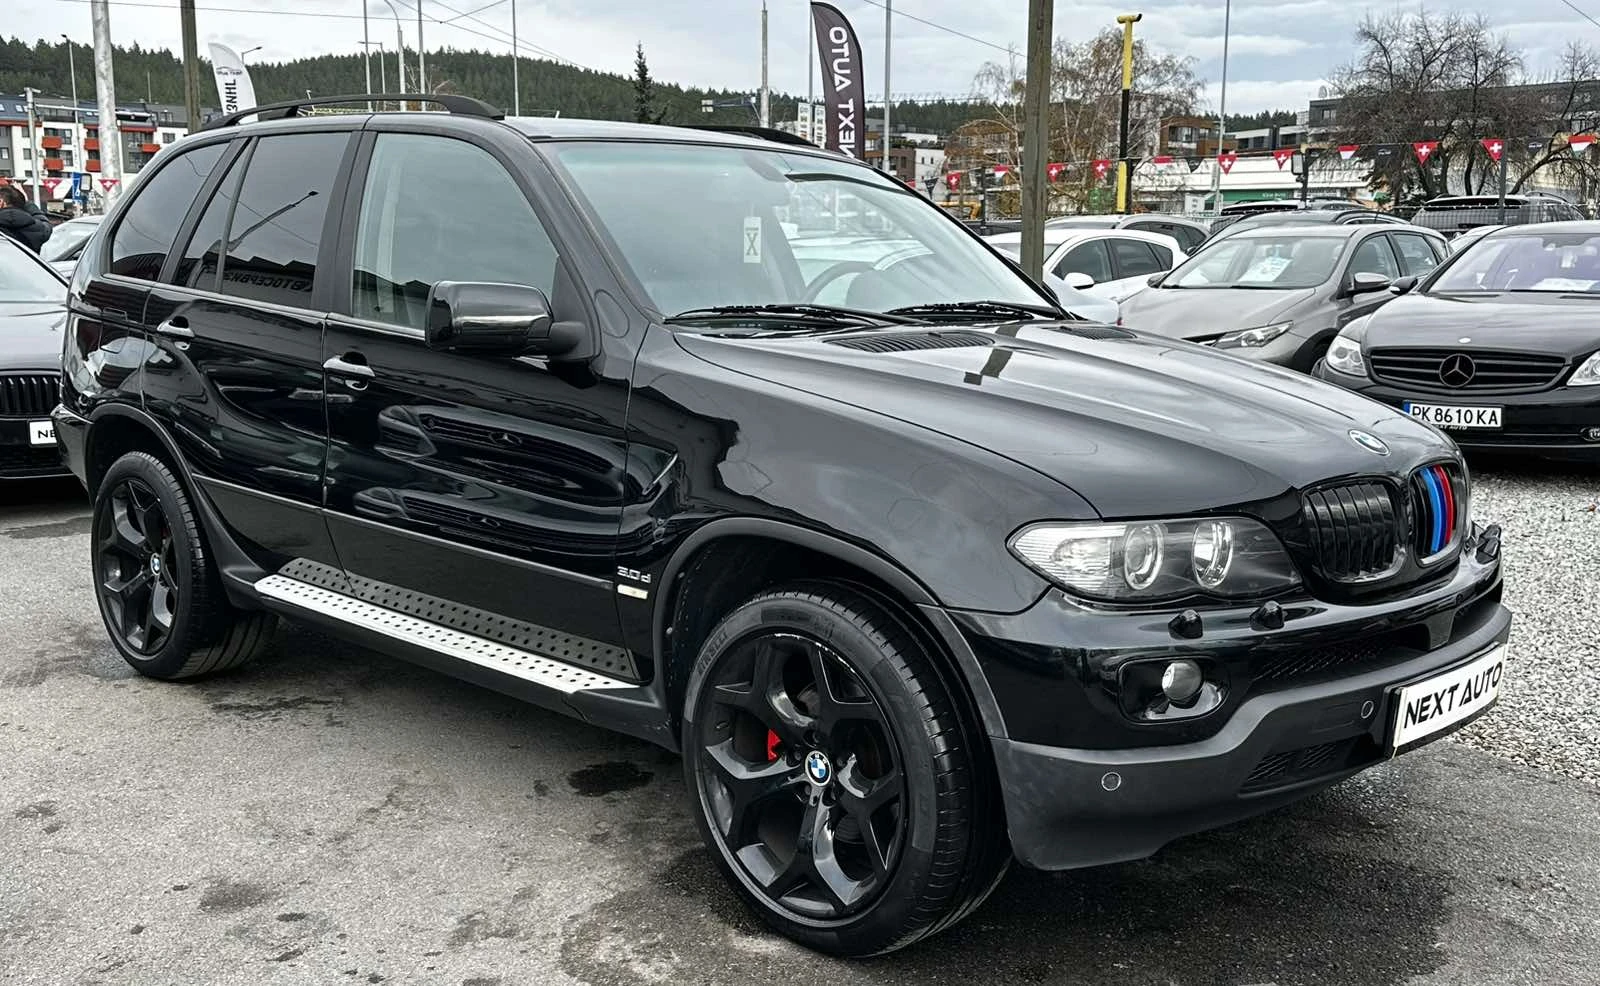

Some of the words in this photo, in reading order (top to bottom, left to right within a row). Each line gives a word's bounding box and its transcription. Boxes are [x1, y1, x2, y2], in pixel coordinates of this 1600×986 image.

[1412, 406, 1431, 421] PK
[1434, 408, 1473, 424] 8610
[1477, 409, 1498, 425] KA
[617, 566, 651, 583] 3.0d
[1404, 683, 1460, 729] NEXT
[1459, 661, 1502, 707] AUTO
